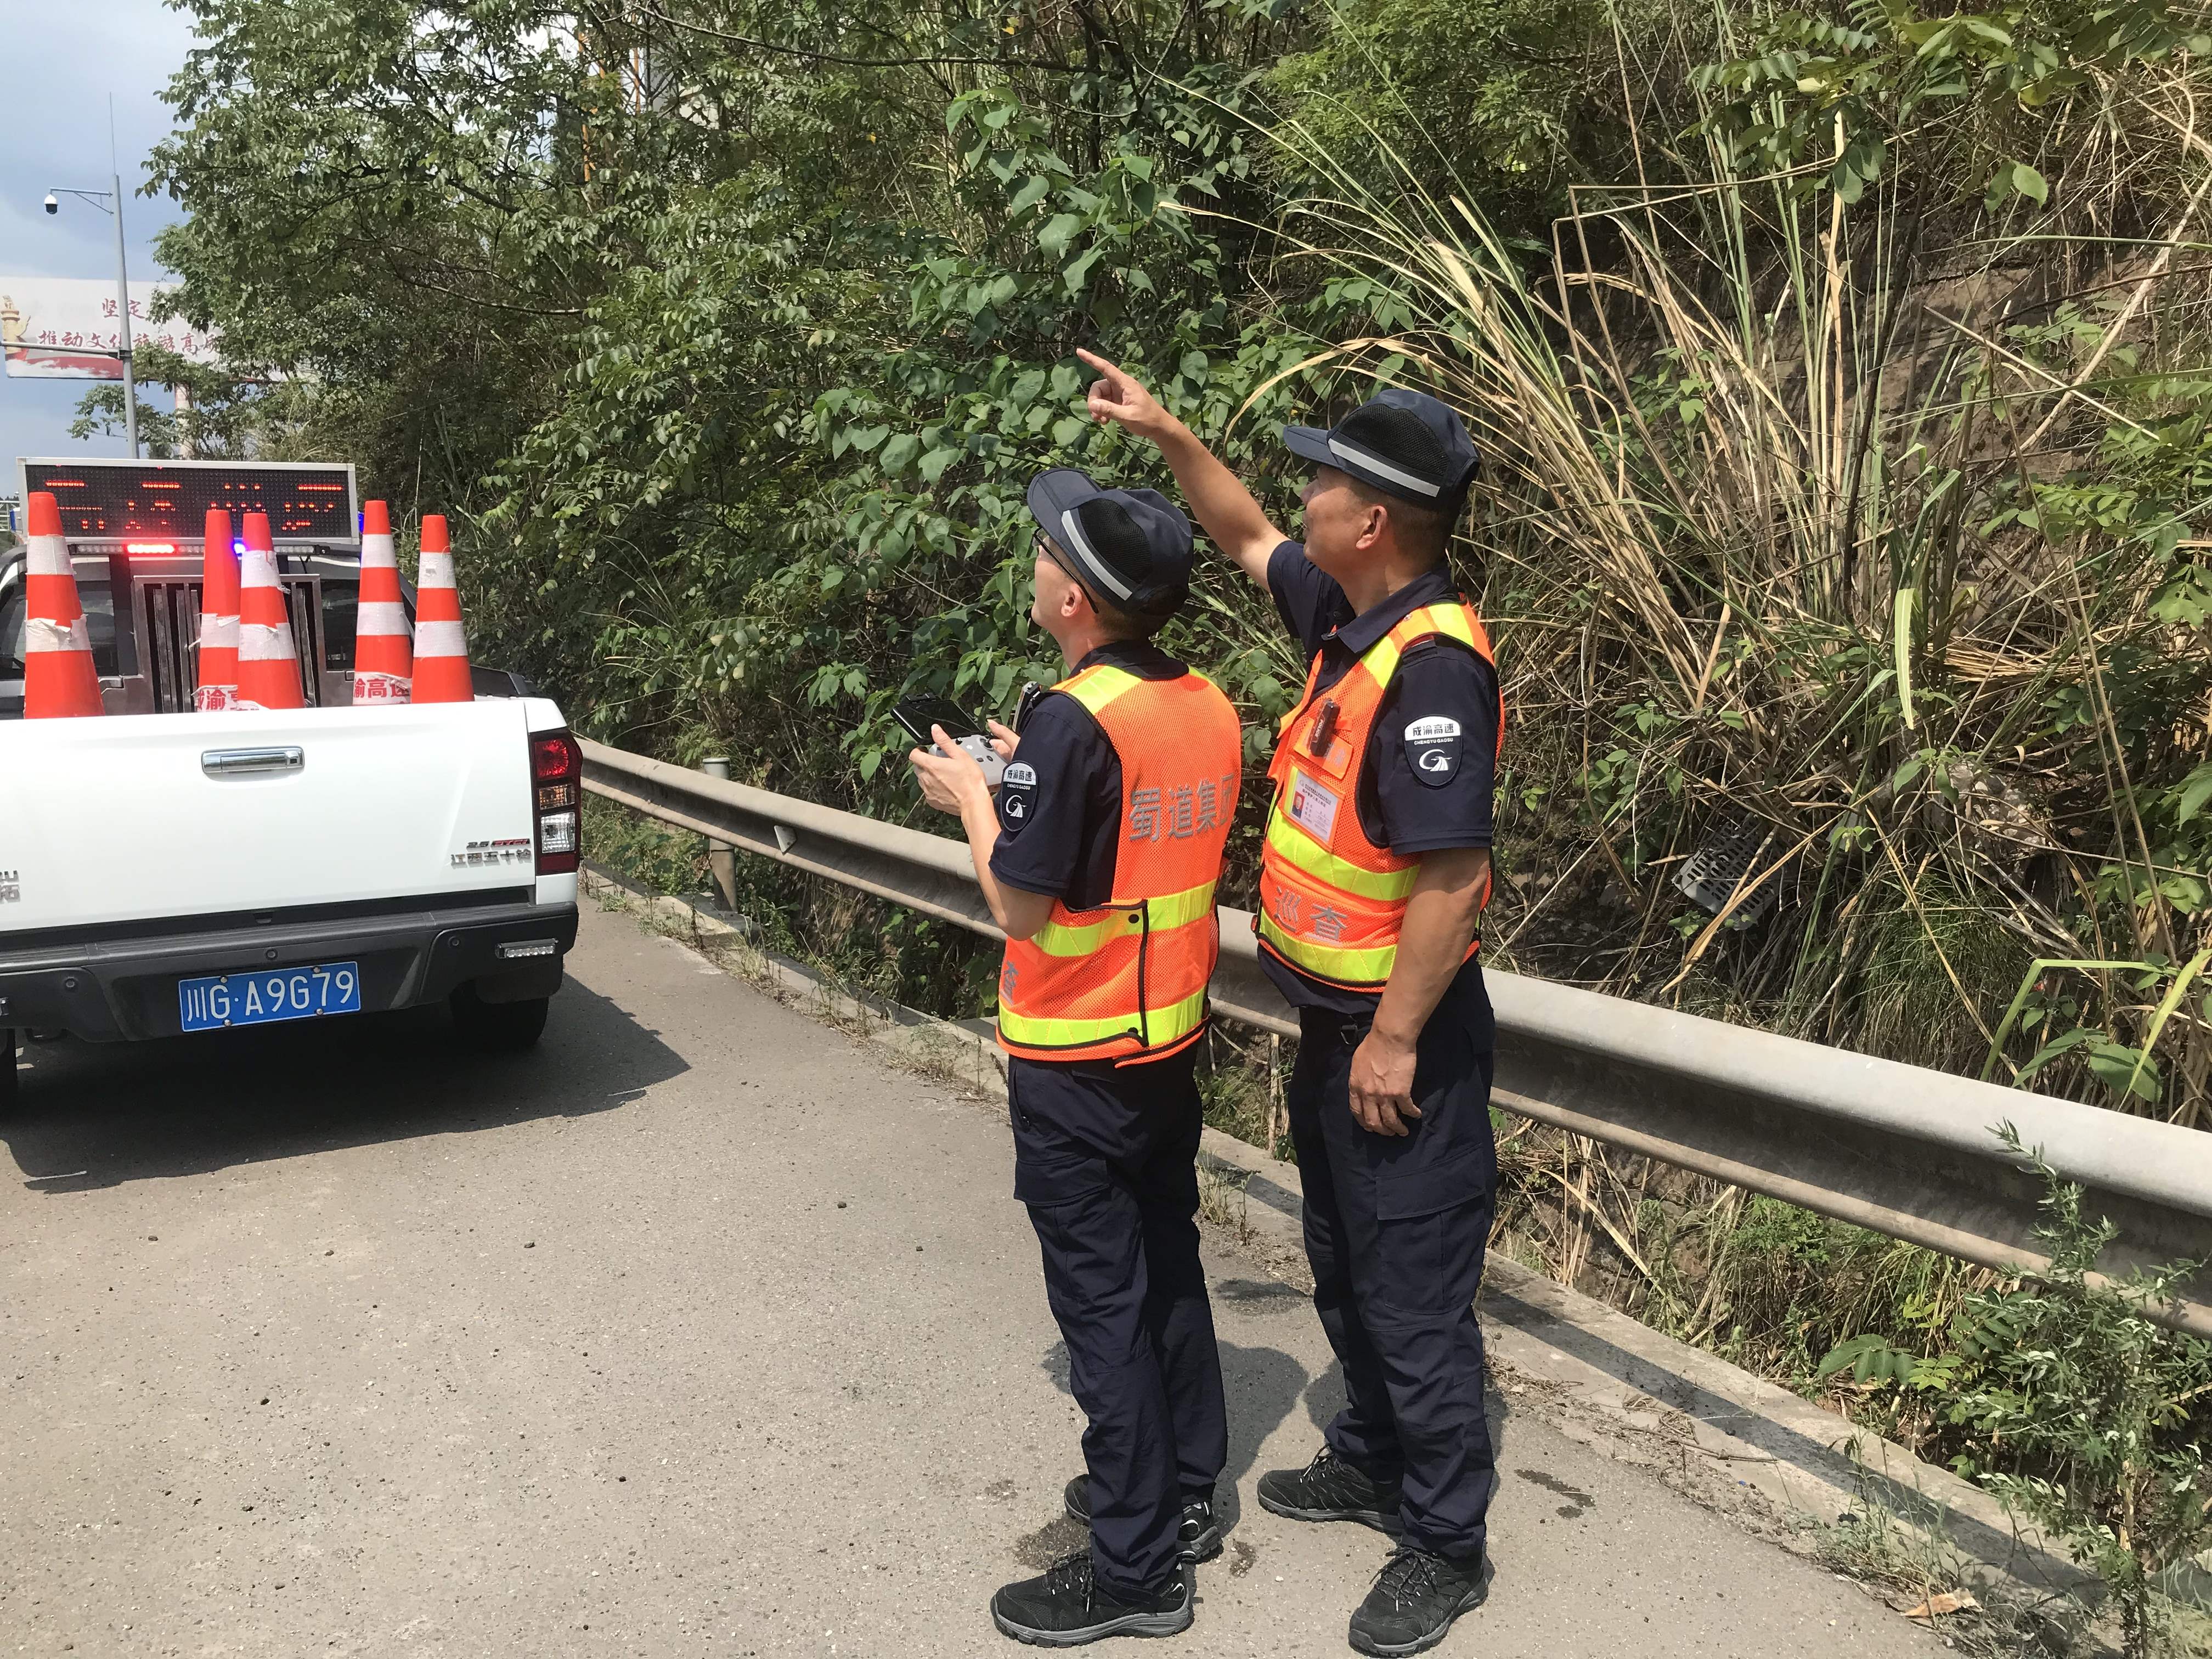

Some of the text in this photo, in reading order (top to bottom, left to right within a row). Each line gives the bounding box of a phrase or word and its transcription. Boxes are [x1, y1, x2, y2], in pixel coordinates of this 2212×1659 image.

[1413, 723, 1454, 736] 成渝高速
[451, 848, 532, 867] 江西五十铃
[1273, 885, 1348, 946] 巡查
